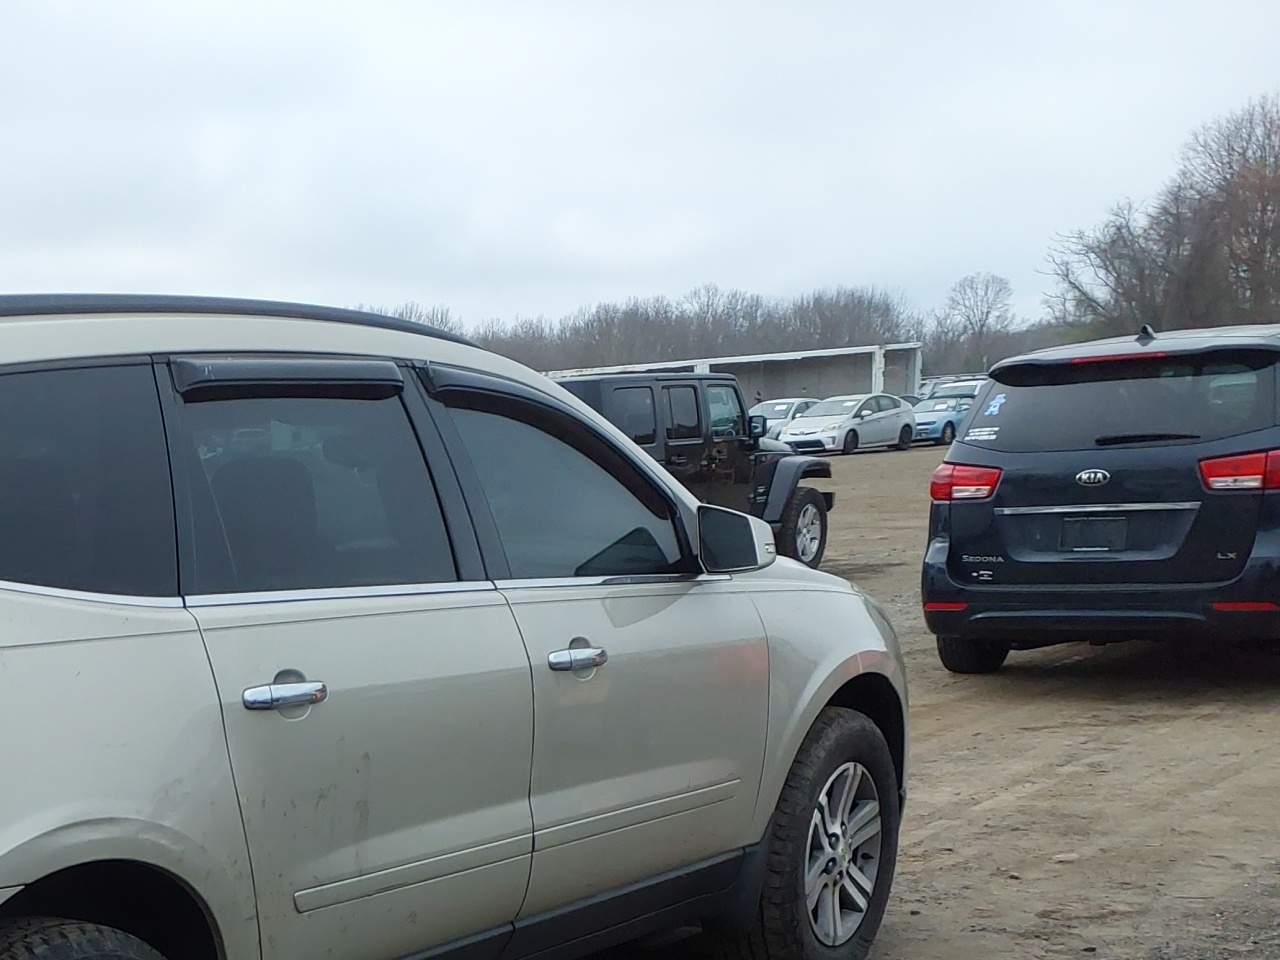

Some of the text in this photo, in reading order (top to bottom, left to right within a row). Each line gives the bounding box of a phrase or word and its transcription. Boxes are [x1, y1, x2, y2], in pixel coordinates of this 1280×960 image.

[1081, 472, 1104, 483] KIA
[961, 554, 1005, 563] SEDONA
[1216, 551, 1238, 560] LX
